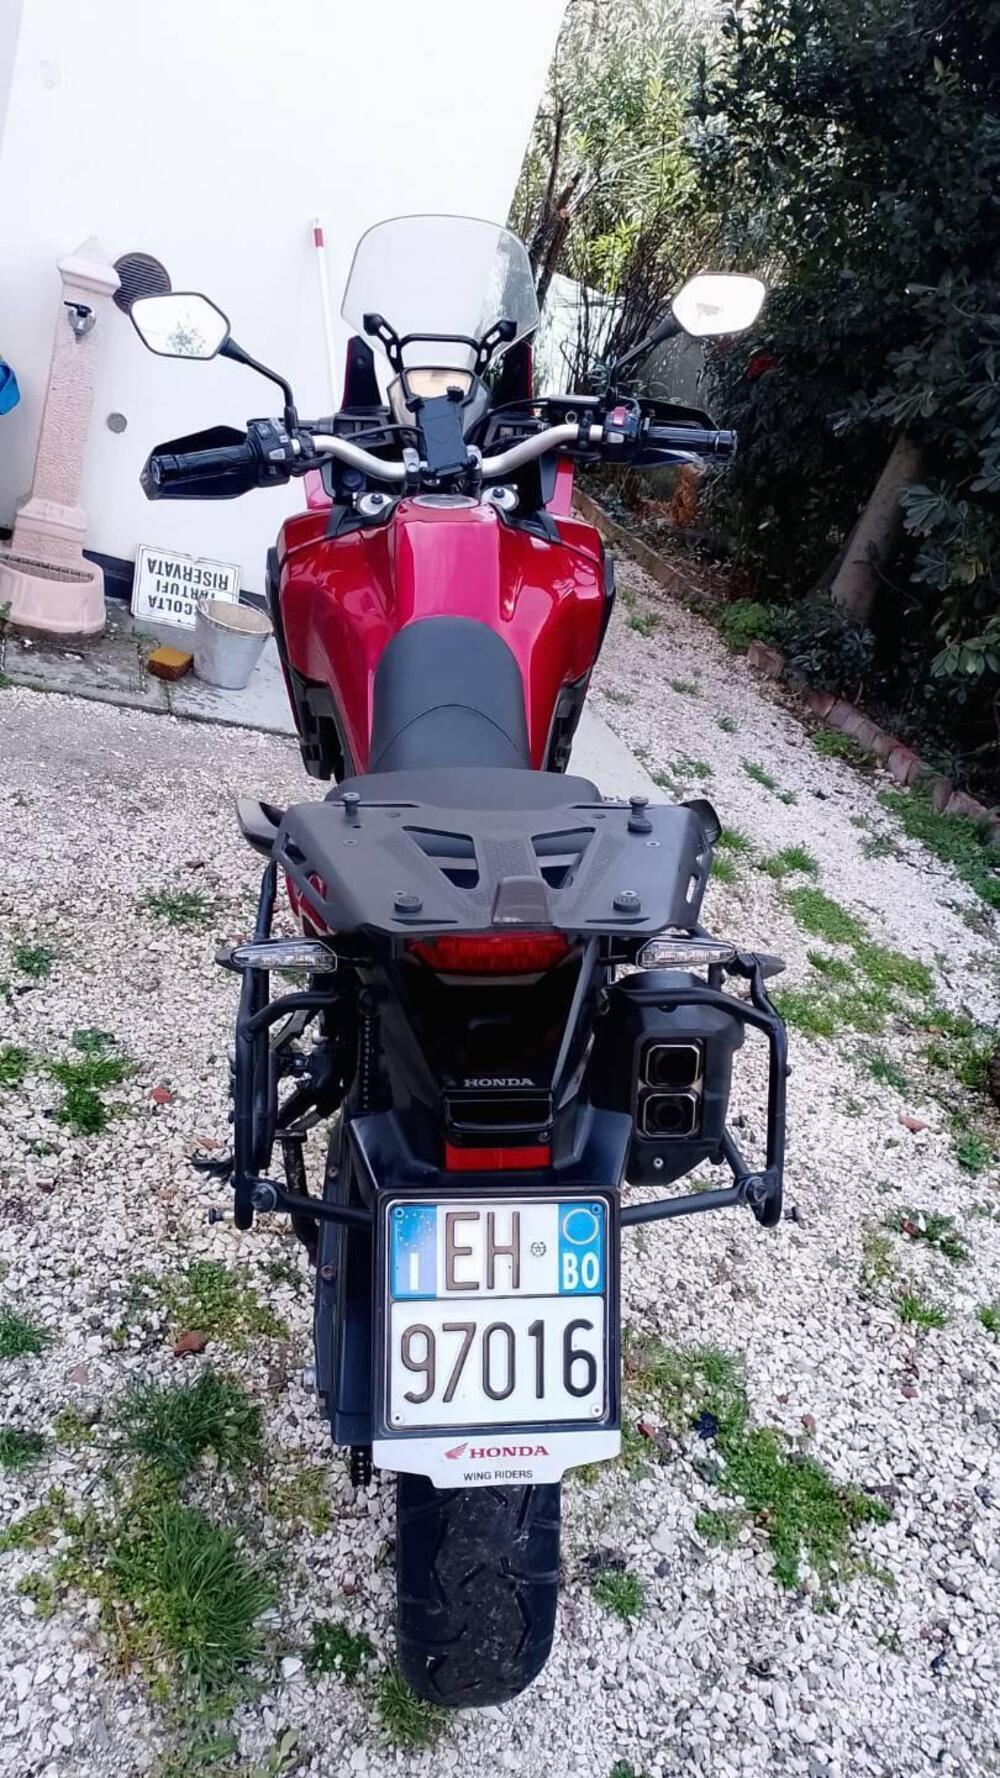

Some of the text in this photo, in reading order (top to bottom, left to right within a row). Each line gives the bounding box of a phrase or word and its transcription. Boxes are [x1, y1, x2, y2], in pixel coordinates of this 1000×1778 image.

[147, 557, 229, 591] RISERVATA
[148, 594, 197, 616] COLTA
[463, 1078, 536, 1088] HONDA
[445, 1211, 521, 1291] EH
[409, 1252, 419, 1291] I
[563, 1252, 600, 1290] BO
[400, 1318, 598, 1405] 97016
[469, 1445, 550, 1459] HONDA
[464, 1470, 533, 1481] WING RIDERS
